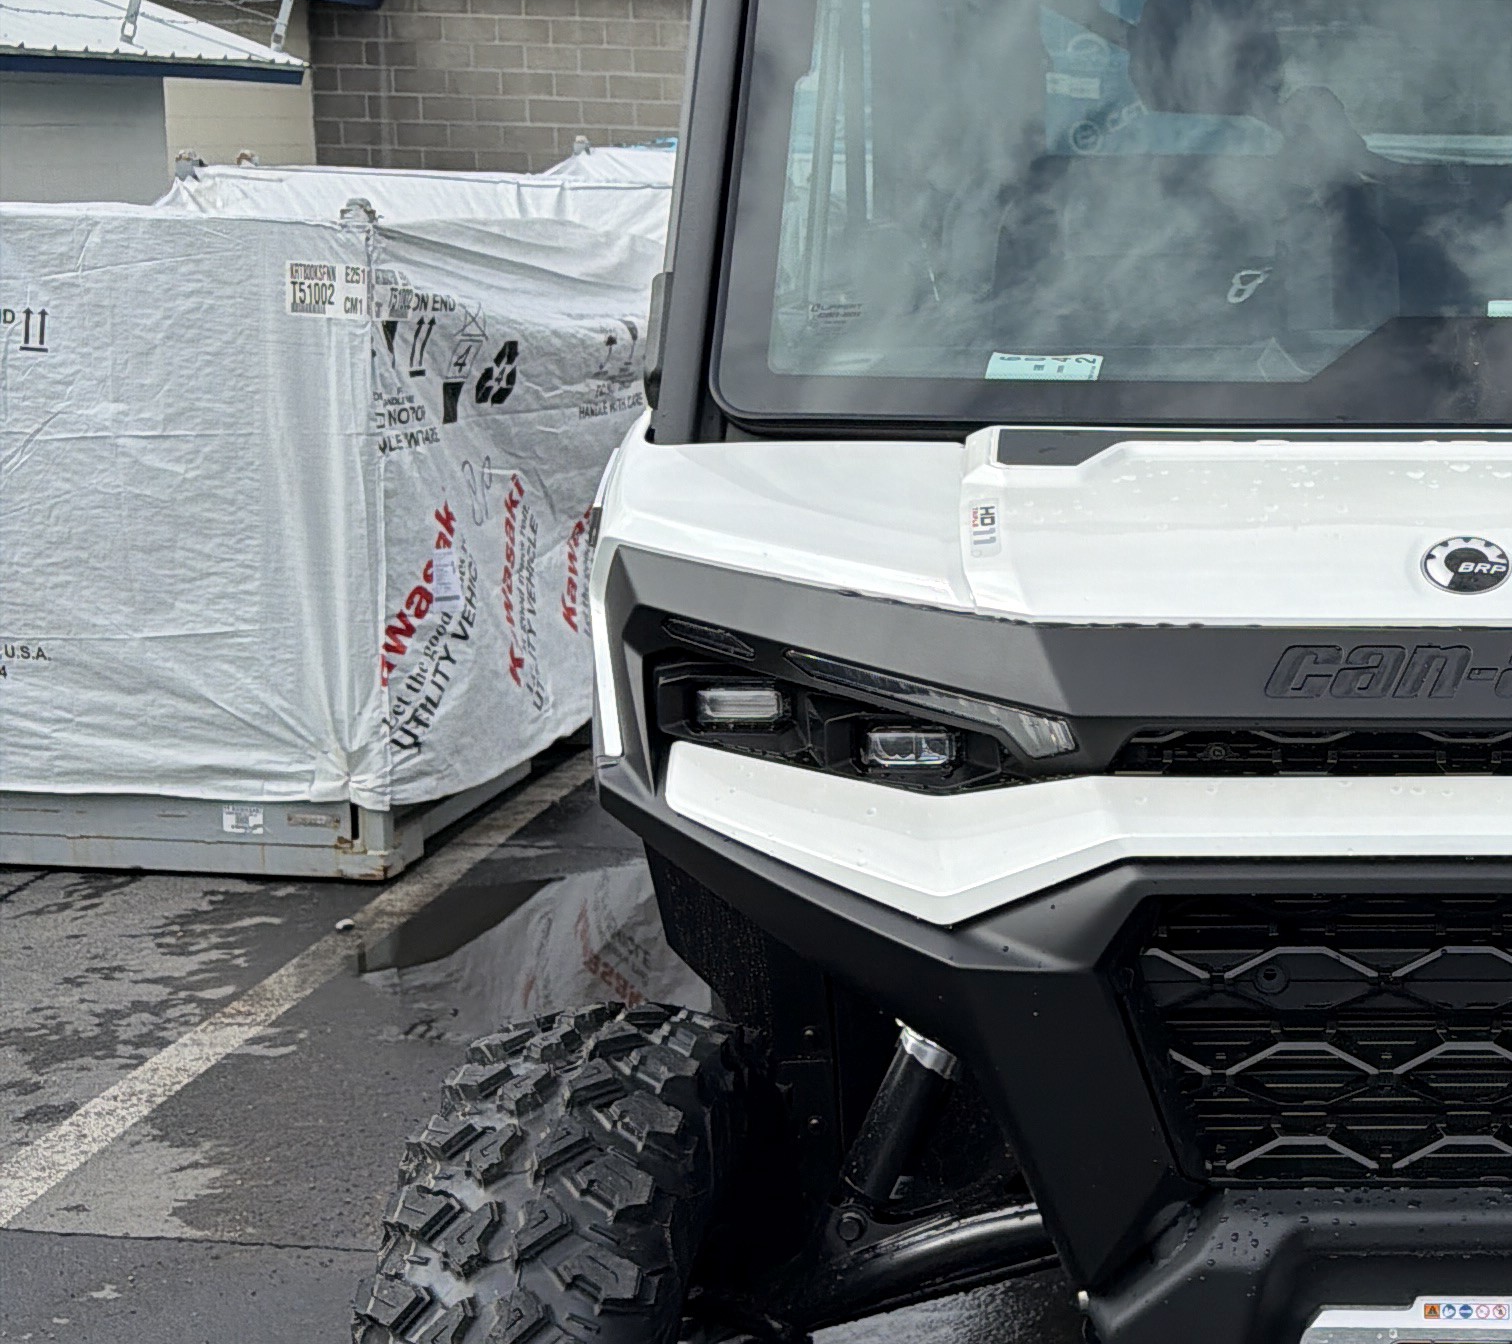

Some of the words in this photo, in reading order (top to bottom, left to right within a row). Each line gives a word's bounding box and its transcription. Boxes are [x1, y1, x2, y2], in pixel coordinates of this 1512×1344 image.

[290, 281, 335, 305] T51002
[344, 296, 363, 316] CM1
[502, 472, 525, 688] Kwasaki
[1458, 561, 1508, 574] BRP
[4, 643, 52, 662] U.S.A.
